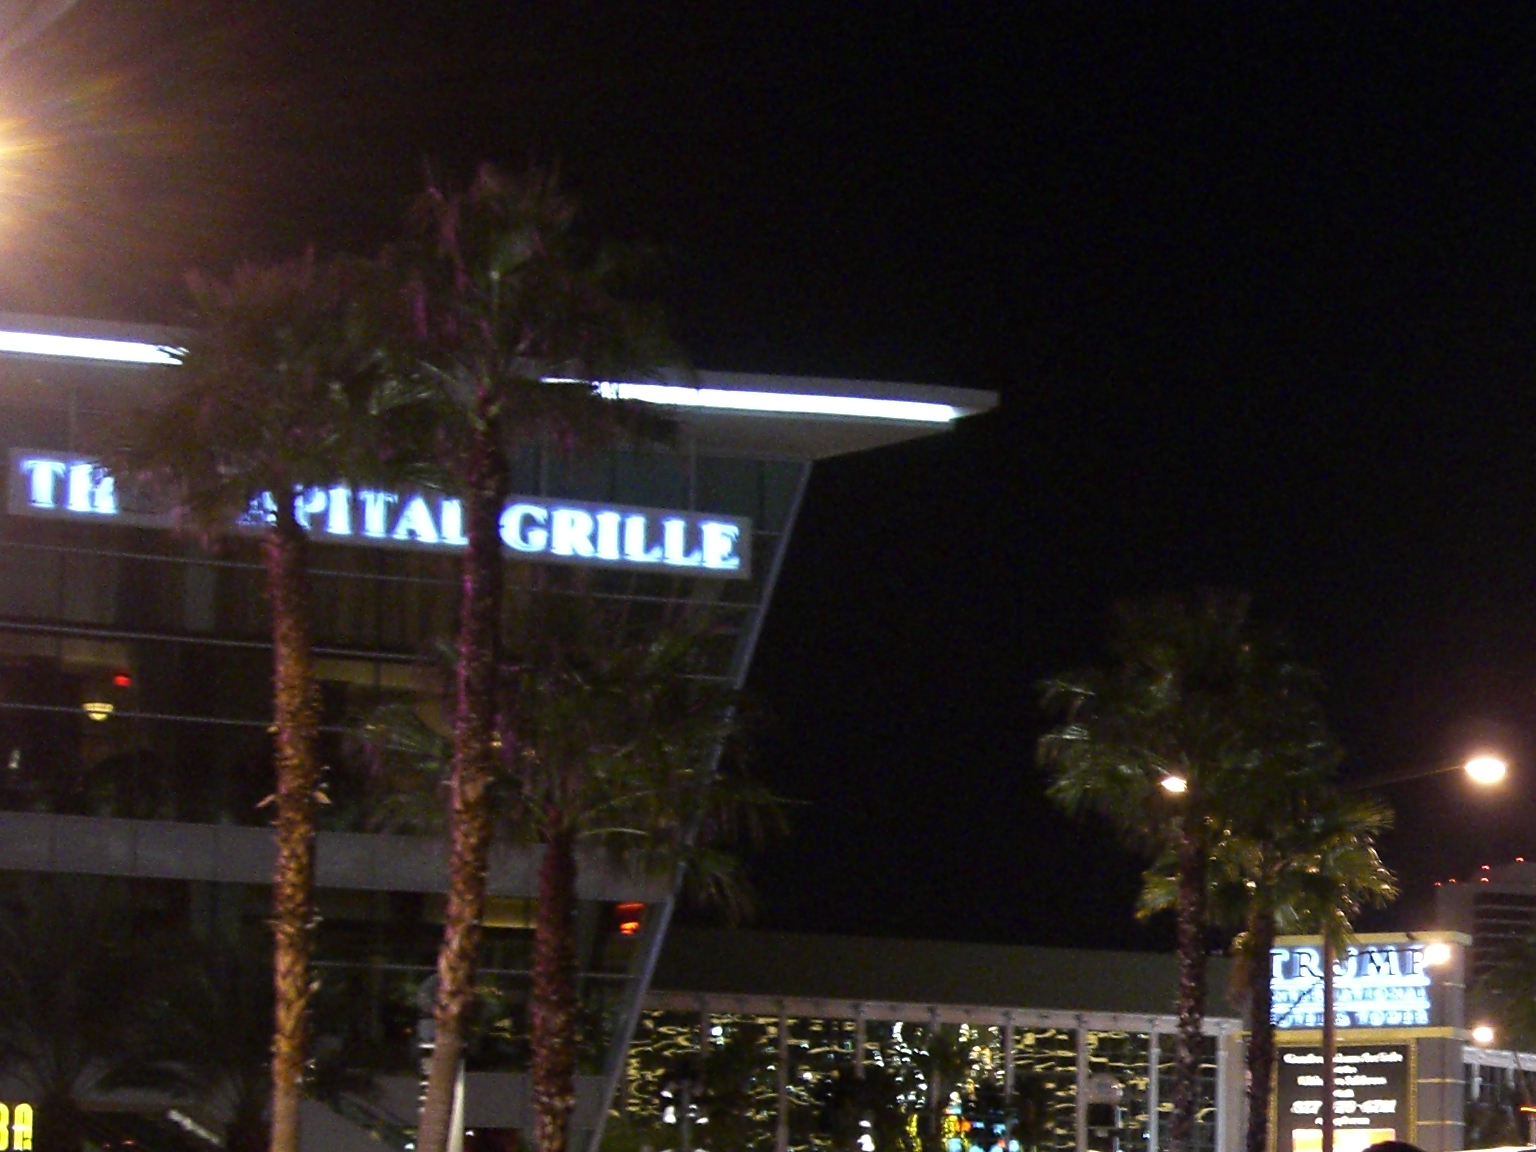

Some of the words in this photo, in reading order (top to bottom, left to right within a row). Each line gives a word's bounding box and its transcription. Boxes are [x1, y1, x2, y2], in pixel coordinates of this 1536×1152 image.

[20, 458, 119, 515] TH
[236, 478, 469, 546] APITAL
[499, 503, 740, 570] GRILLE
[1269, 945, 1425, 978] TRUMP
